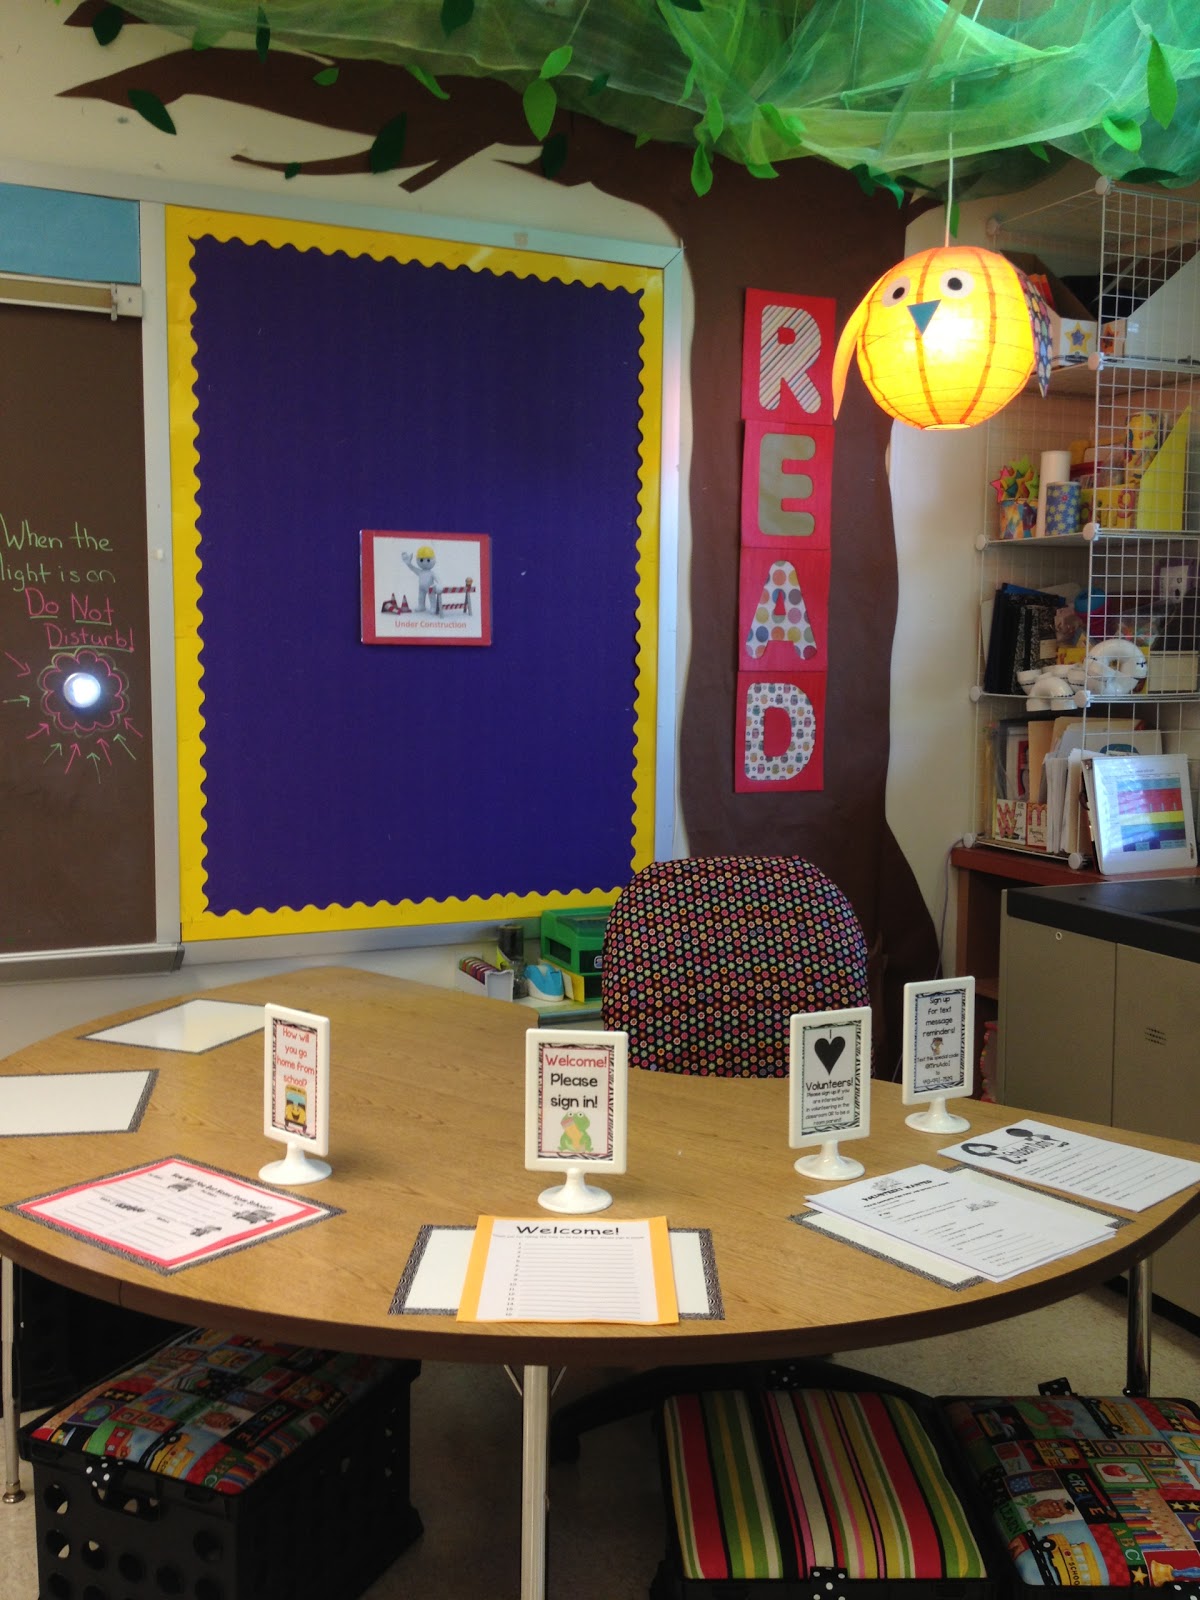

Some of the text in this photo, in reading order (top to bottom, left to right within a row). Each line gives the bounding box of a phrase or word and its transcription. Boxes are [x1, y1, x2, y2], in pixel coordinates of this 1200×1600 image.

[0, 513, 113, 551] When the
[744, 304, 822, 780] READ
[0, 553, 116, 592] light is on
[25, 587, 114, 625] Do Not
[395, 620, 467, 629] Under Construction
[44, 622, 134, 652] Disturb!
[930, 996, 941, 1005] Sign
[928, 1006, 952, 1015] for text
[926, 1018, 953, 1026] message
[283, 1027, 309, 1043] How will
[923, 1027, 955, 1037] reminders!
[285, 1045, 307, 1059] you go
[276, 1055, 314, 1075] home from
[545, 1054, 607, 1068] Welcome!
[284, 1074, 307, 1087] school?
[551, 1072, 598, 1087] Please
[805, 1077, 853, 1091] Volunteers!
[551, 1095, 598, 1110] sign in!
[517, 1226, 619, 1235] Welcome!
[1066, 1472, 1106, 1516] CREE
